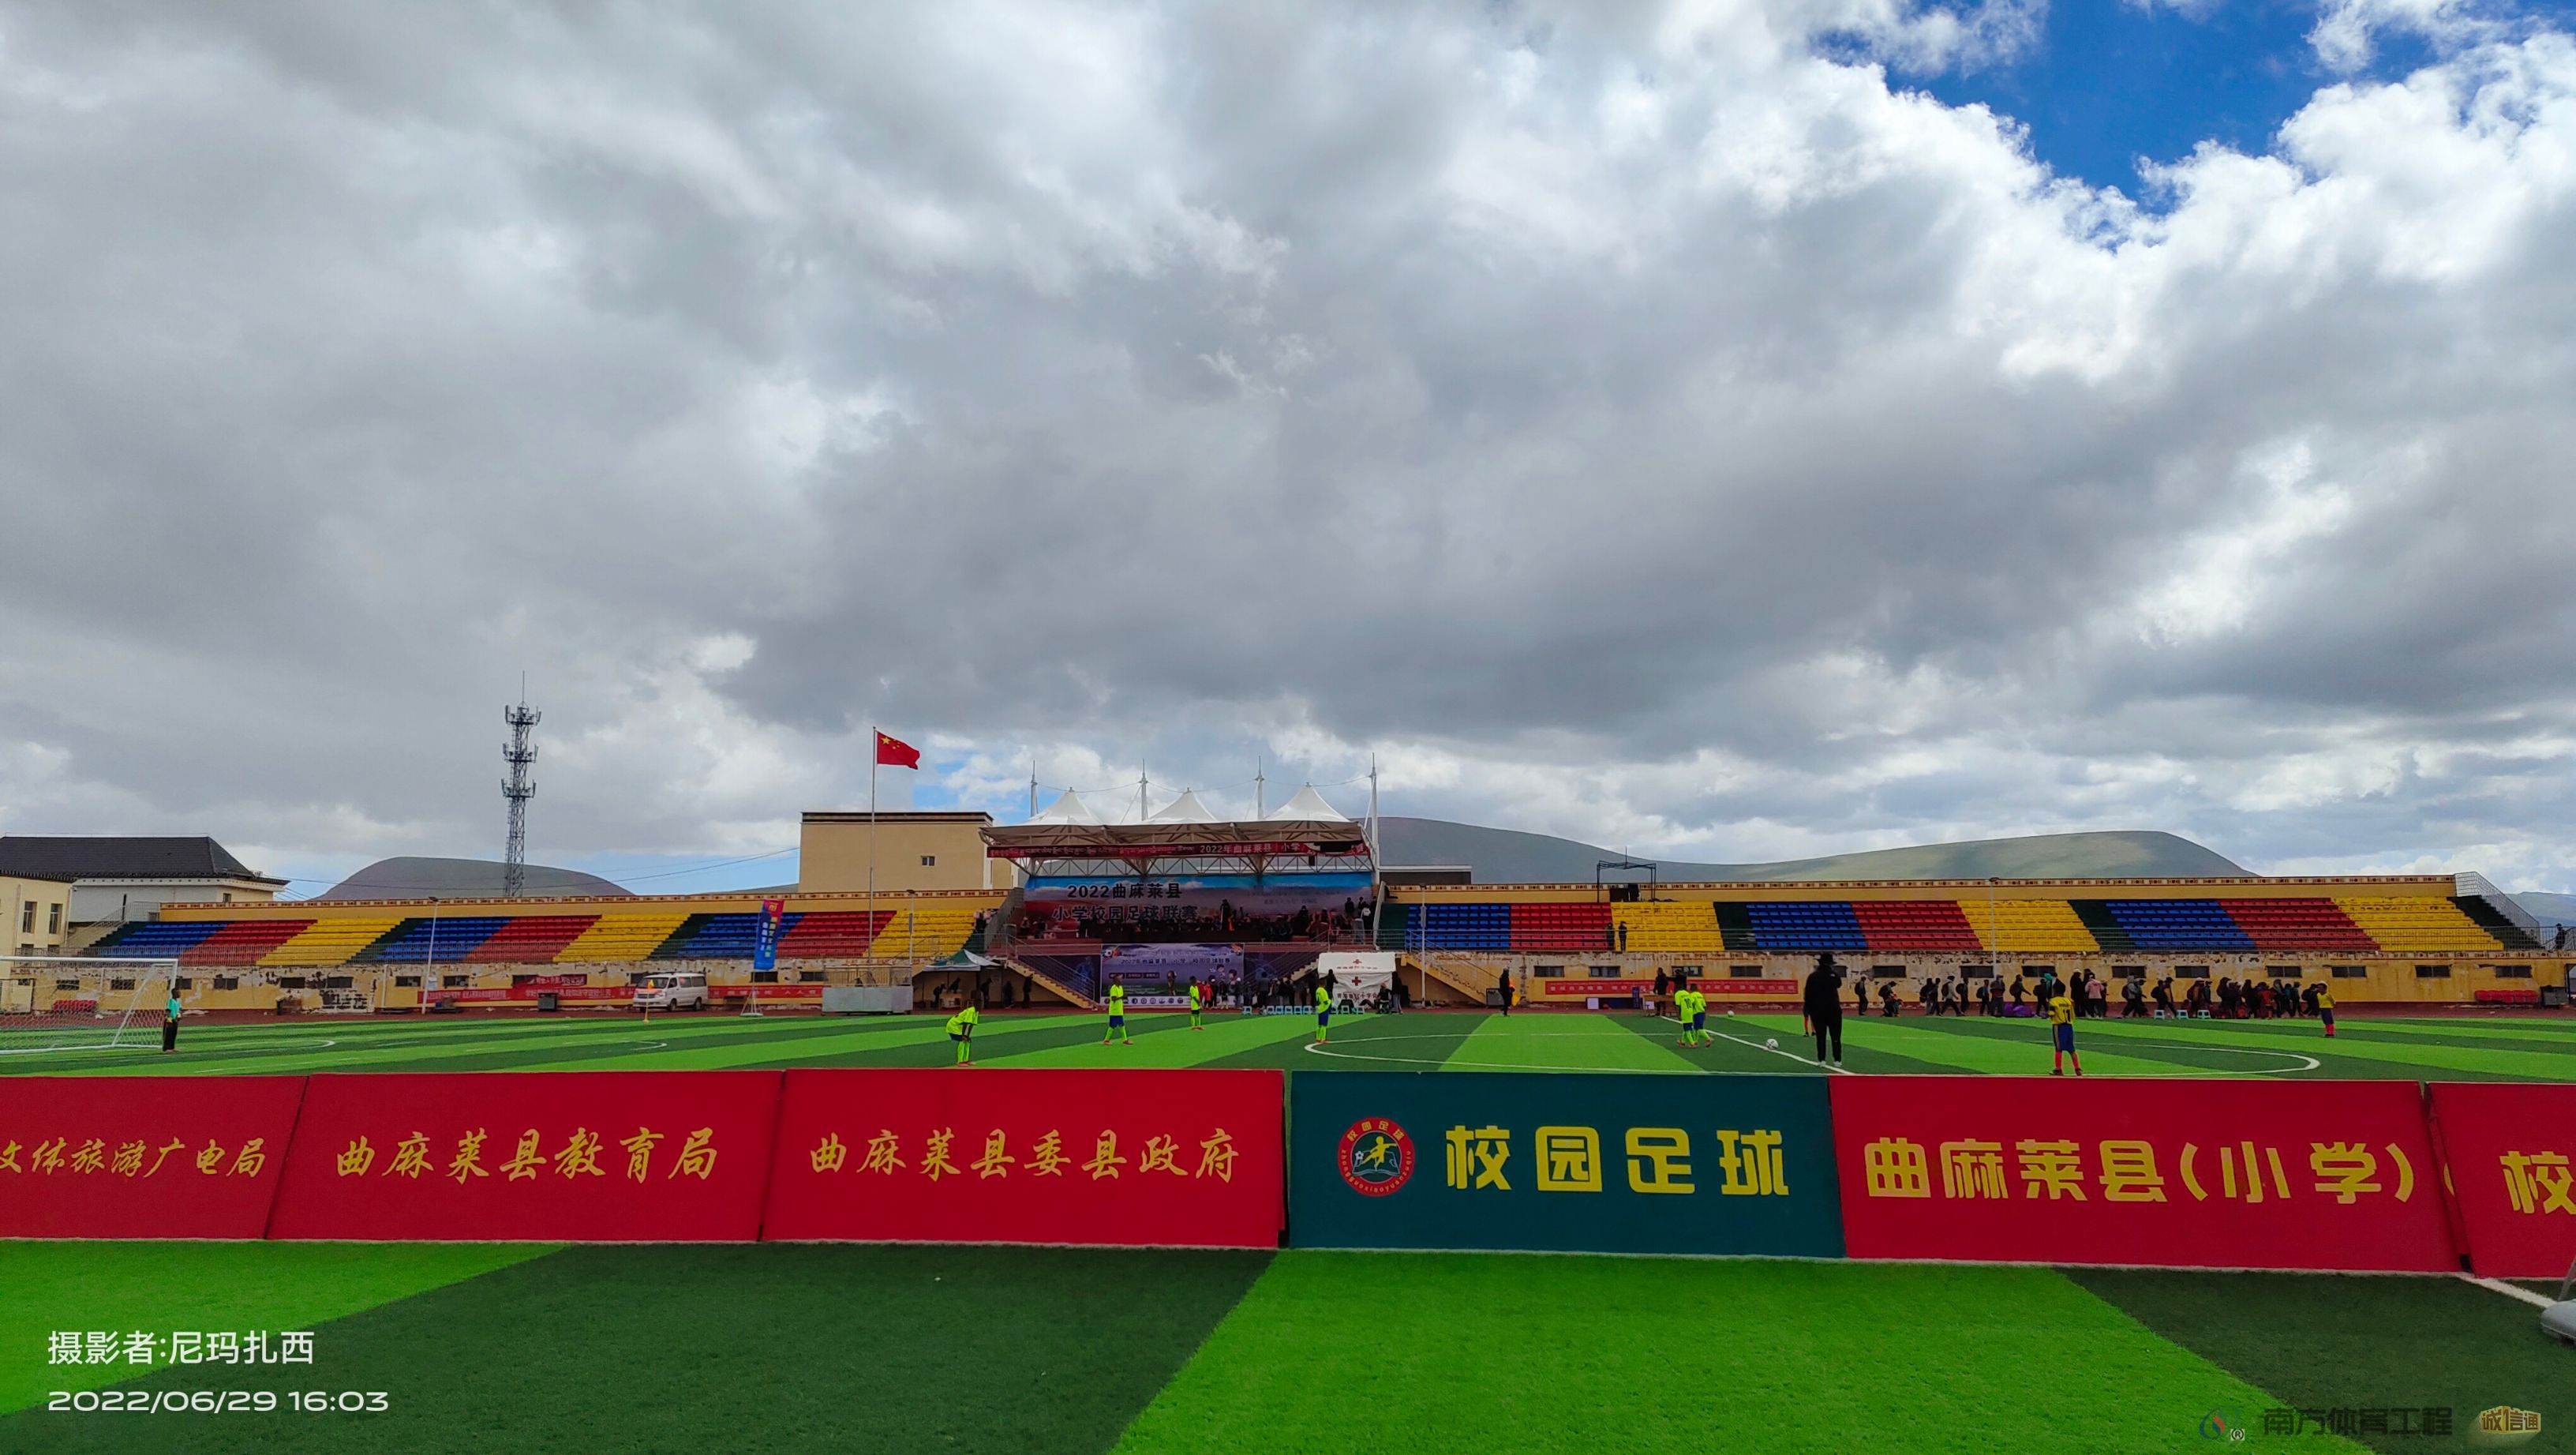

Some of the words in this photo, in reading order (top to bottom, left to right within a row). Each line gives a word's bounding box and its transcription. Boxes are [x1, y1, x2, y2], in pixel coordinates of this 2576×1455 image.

[1052, 905, 1198, 922] 小学校园足球联赛
[1067, 883, 1182, 899] 2022曲麻莱县
[0, 1137, 266, 1178] 文体旅游广电局
[337, 1127, 717, 1184] 曲麻莱县教育局
[810, 1127, 1239, 1183] 曲麻莱县委县政府
[1446, 1126, 1788, 1195] 校园足球
[1865, 1138, 2414, 1204] 曲麻莱县(小学)
[2500, 1150, 2576, 1214] 校
